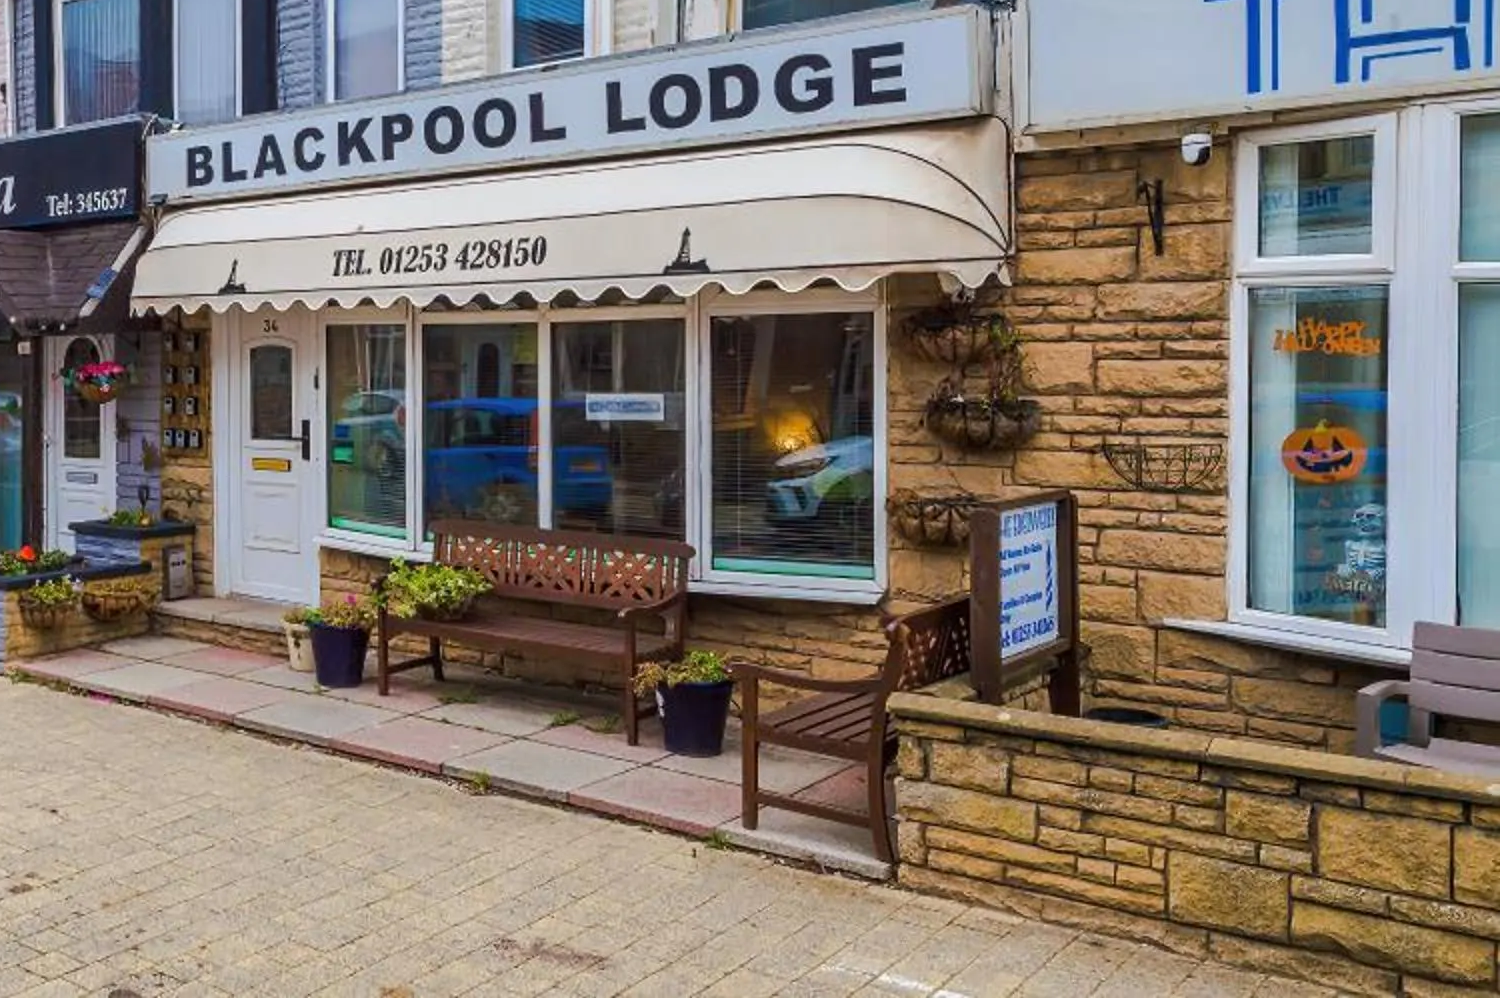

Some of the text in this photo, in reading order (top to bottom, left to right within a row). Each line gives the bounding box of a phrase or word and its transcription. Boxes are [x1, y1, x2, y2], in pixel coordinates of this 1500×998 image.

[186, 41, 907, 188] BLACKPOOL LODGE
[46, 188, 128, 218] Tel: 345637
[332, 236, 548, 277] TEL. 01253 428150
